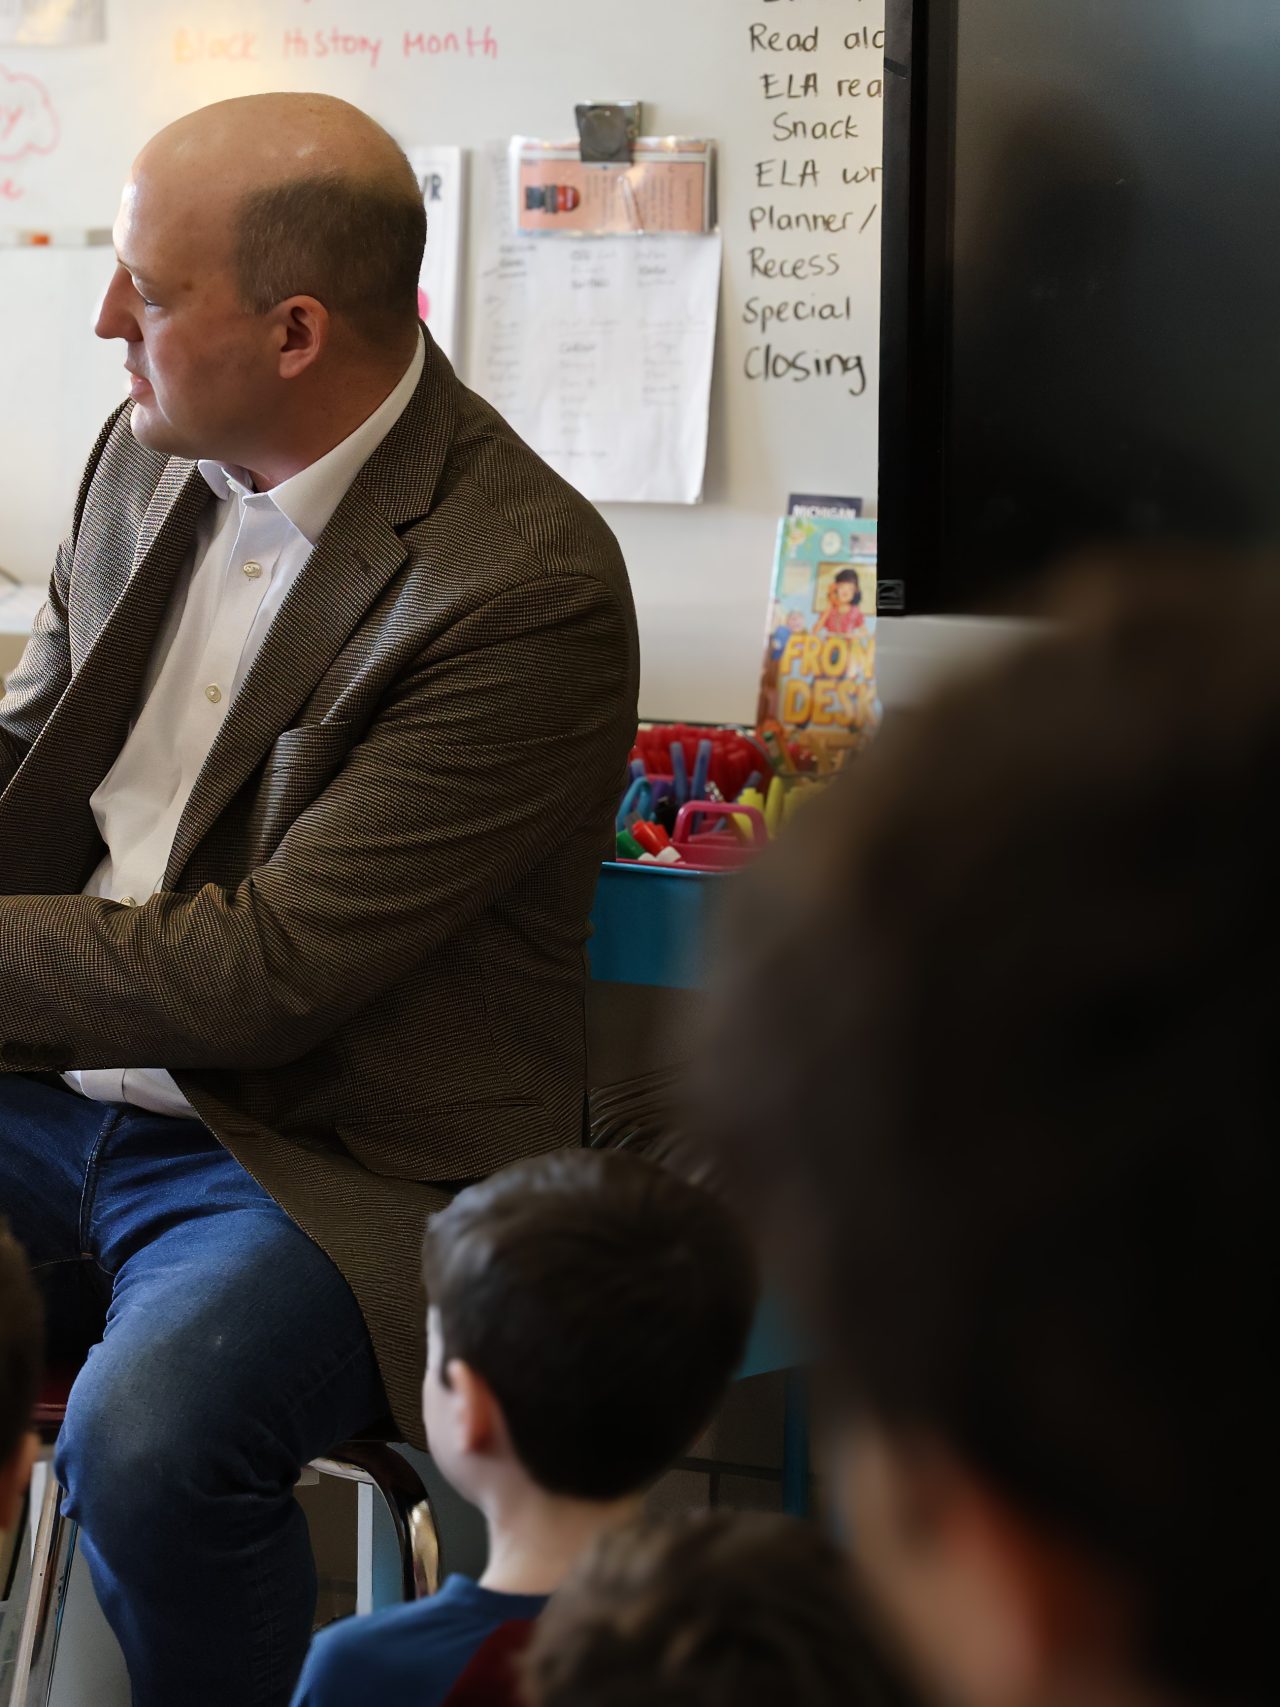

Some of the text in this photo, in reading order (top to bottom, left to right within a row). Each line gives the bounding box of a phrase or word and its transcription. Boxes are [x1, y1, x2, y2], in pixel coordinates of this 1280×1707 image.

[174, 26, 498, 68] Black History Month
[749, 23, 818, 51] Read
[760, 73, 882, 99] ELA rea
[773, 112, 858, 141] Snack
[755, 159, 818, 187] ELA
[749, 247, 840, 280] Recess
[742, 296, 851, 334] Special
[744, 344, 866, 396] Closing
